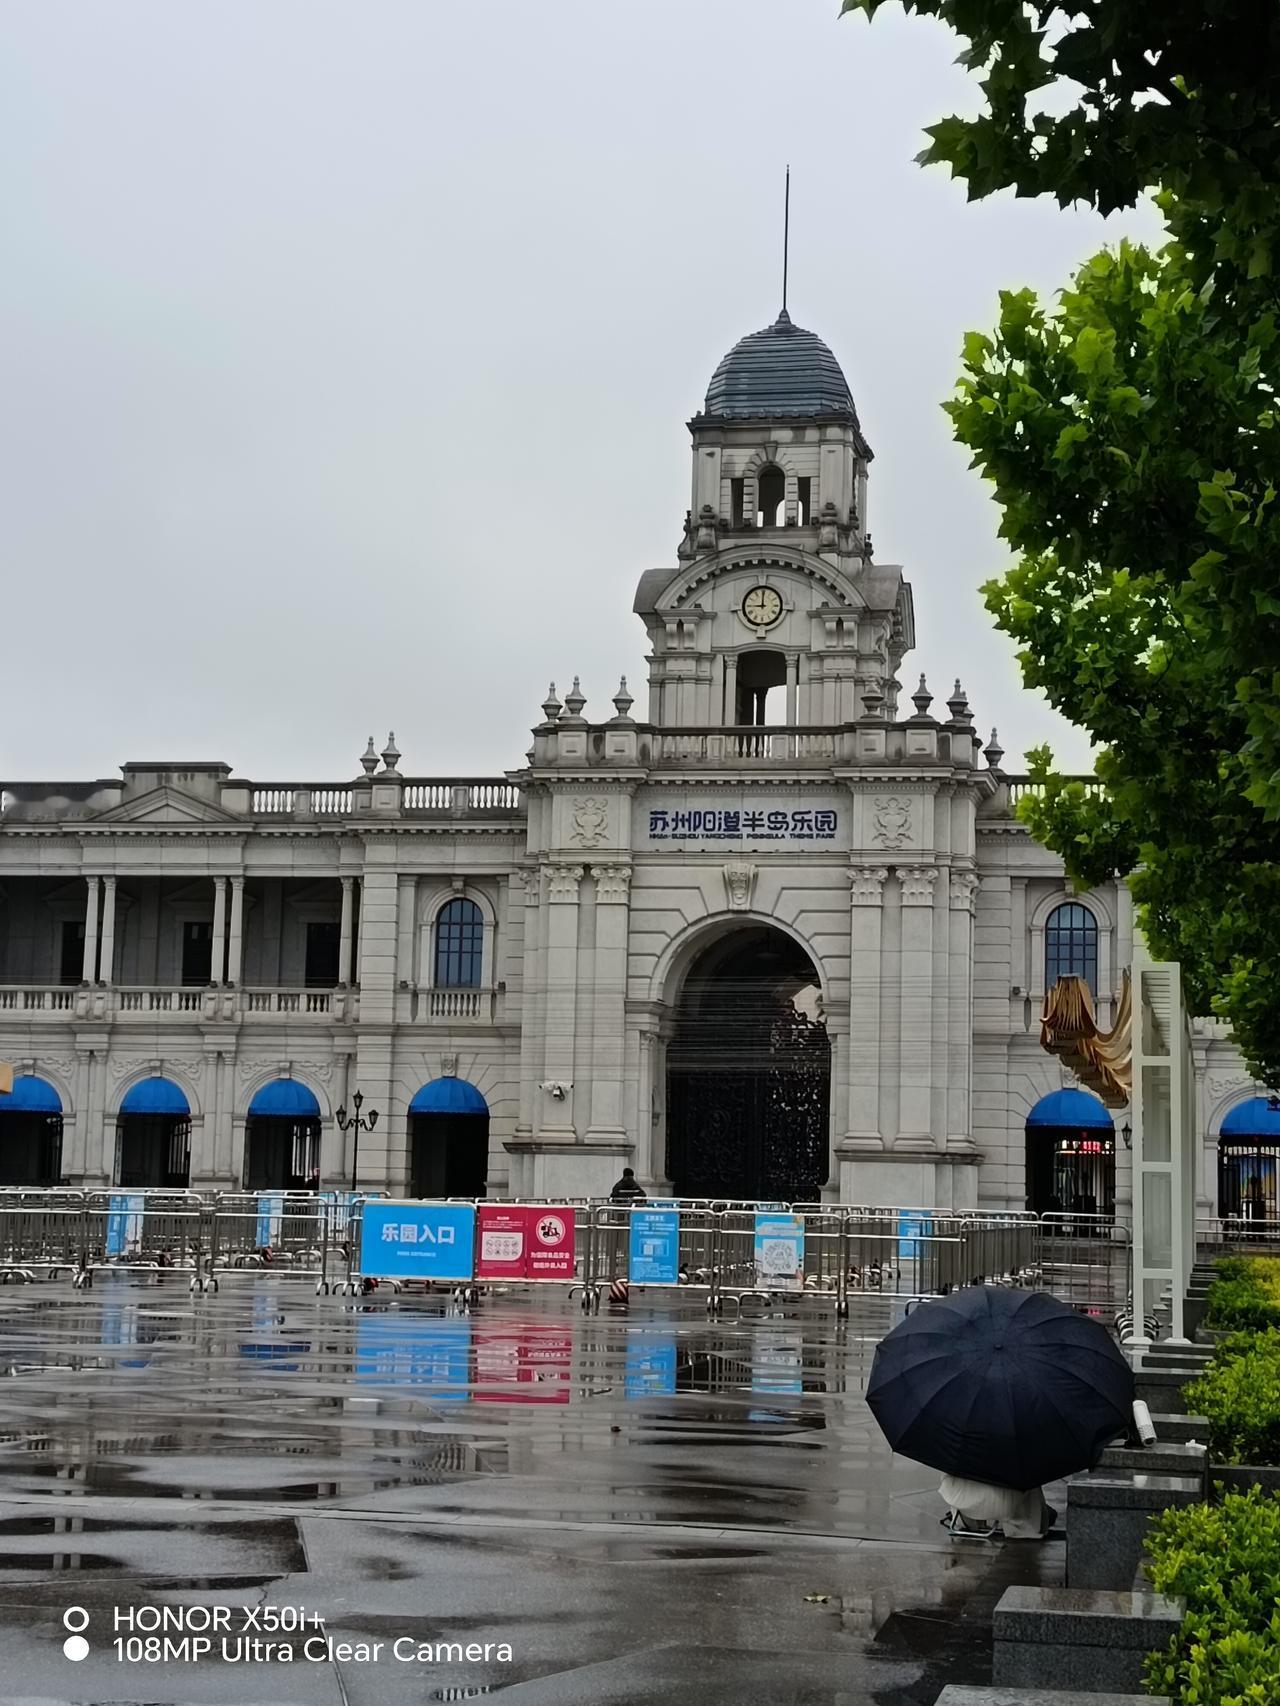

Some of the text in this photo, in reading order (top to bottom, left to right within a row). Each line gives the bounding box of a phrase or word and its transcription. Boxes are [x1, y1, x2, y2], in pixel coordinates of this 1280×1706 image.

[649, 810, 837, 832] 苏州阳澄半岛乐园
[381, 1223, 455, 1244] 乐园入口
